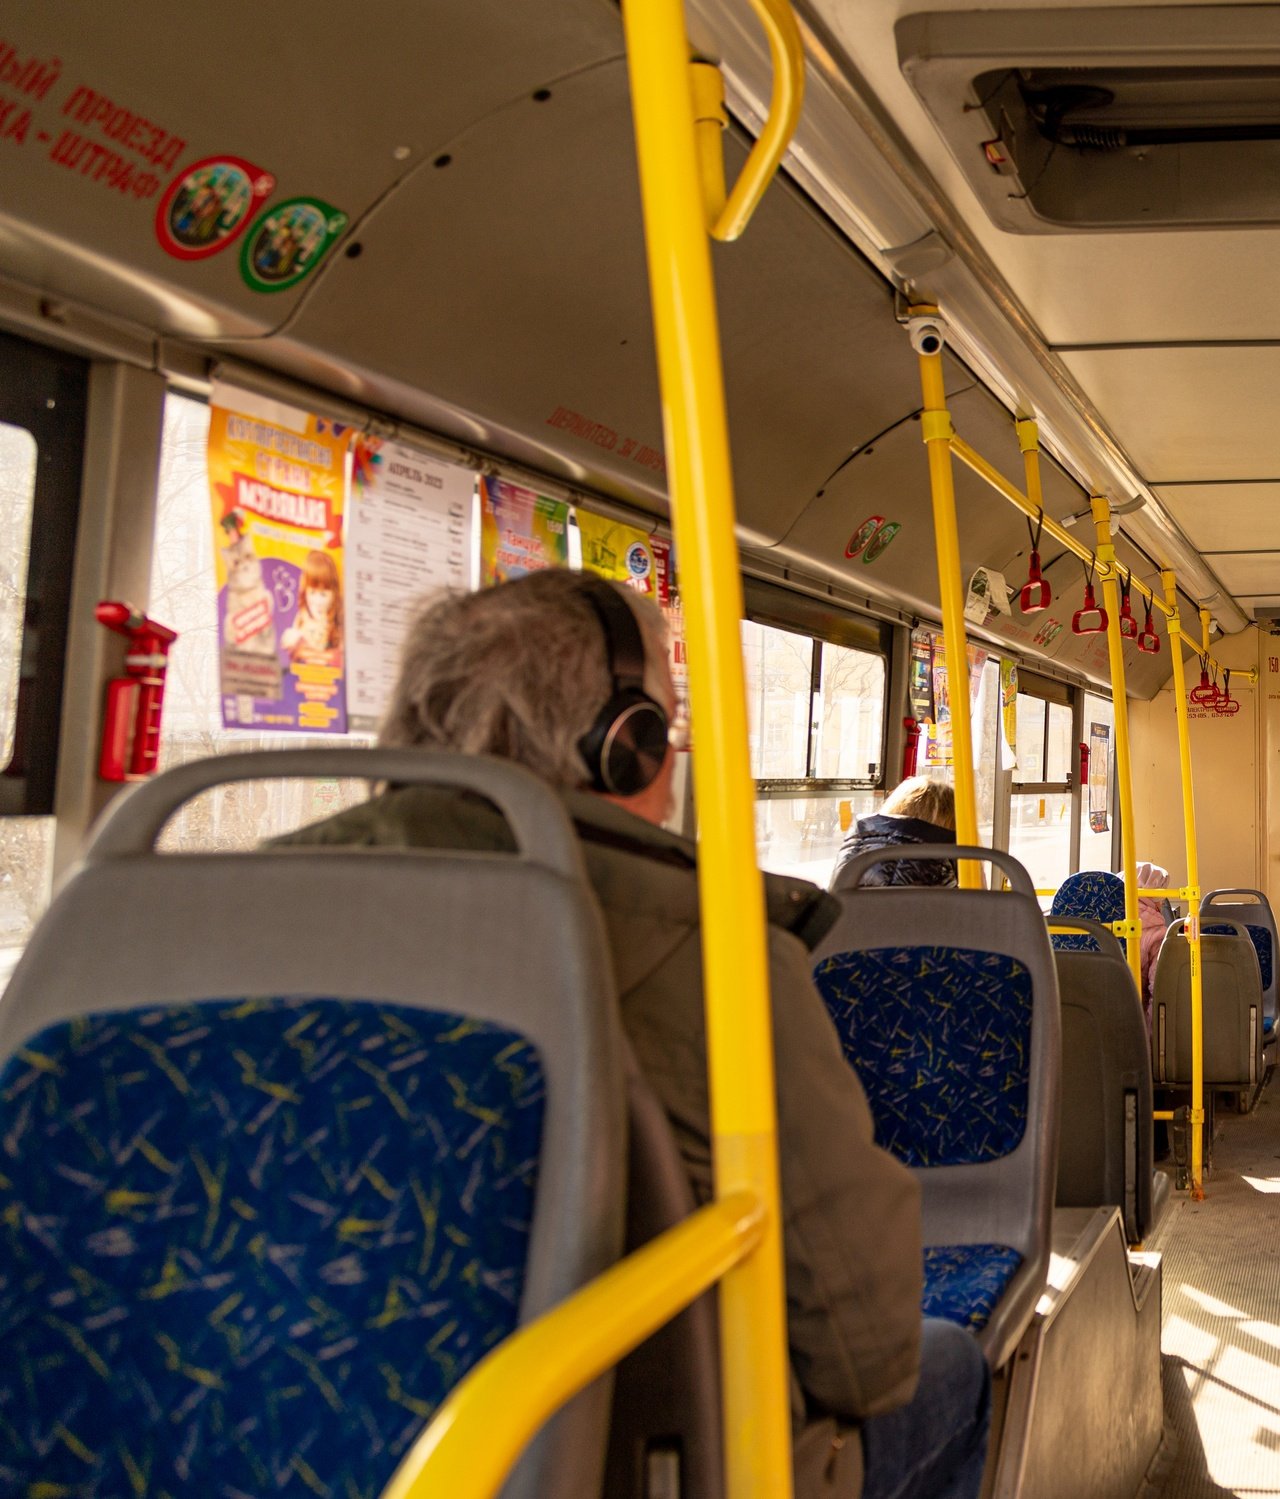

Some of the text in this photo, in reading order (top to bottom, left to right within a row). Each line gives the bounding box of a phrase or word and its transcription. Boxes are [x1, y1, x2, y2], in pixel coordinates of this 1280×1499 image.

[0, 40, 187, 173] ЫЙ ПРОЕЗД
[50, 129, 161, 199] ШТРАФ
[1268, 656, 1280, 673] 150
